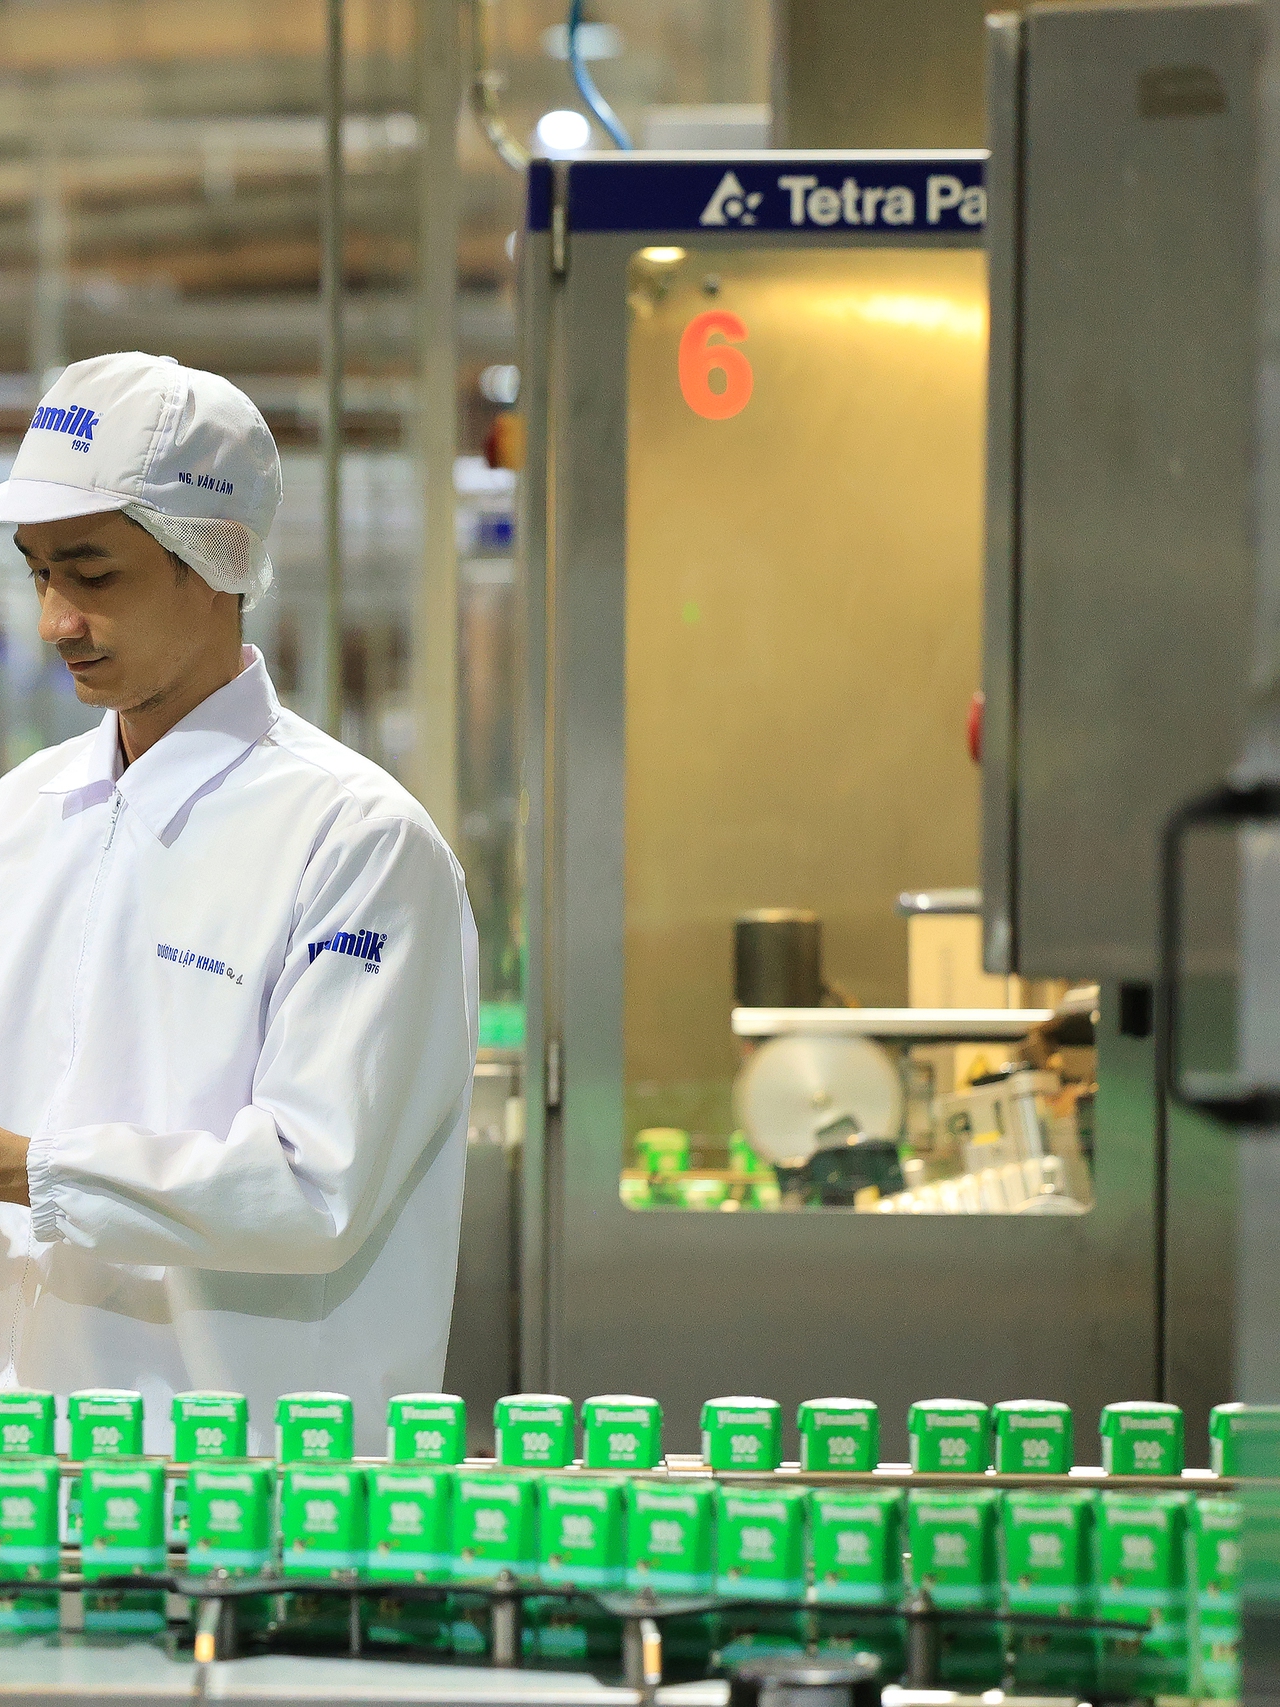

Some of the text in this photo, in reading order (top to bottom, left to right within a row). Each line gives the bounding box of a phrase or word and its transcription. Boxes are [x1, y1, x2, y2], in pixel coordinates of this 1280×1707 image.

[779, 176, 914, 226] Tetra
[678, 309, 754, 421] 6
[71, 439, 91, 454] 1976
[197, 474, 216, 490] VĂN
[215, 479, 234, 495] LÂM
[195, 955, 226, 975] KHANG
[364, 962, 380, 975] 1976
